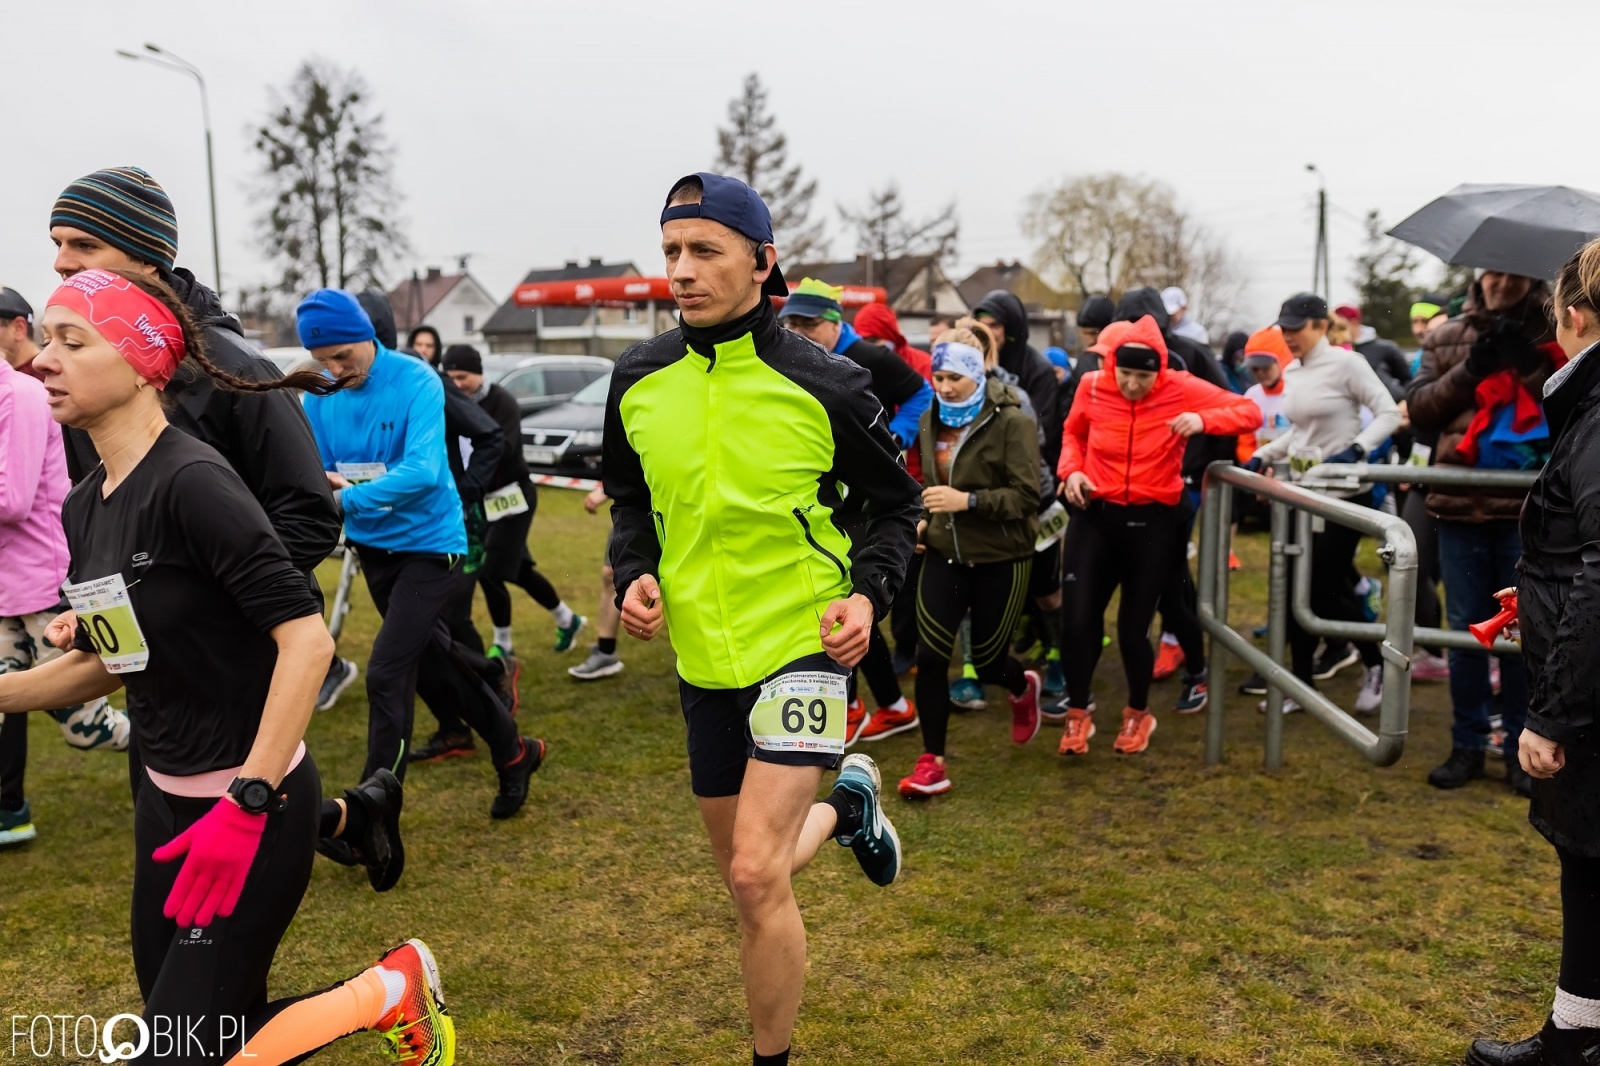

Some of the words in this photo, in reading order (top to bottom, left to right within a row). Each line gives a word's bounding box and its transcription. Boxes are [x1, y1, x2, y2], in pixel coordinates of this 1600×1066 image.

[494, 494, 518, 512] 108
[1039, 515, 1064, 540] 119
[781, 697, 827, 735] 69
